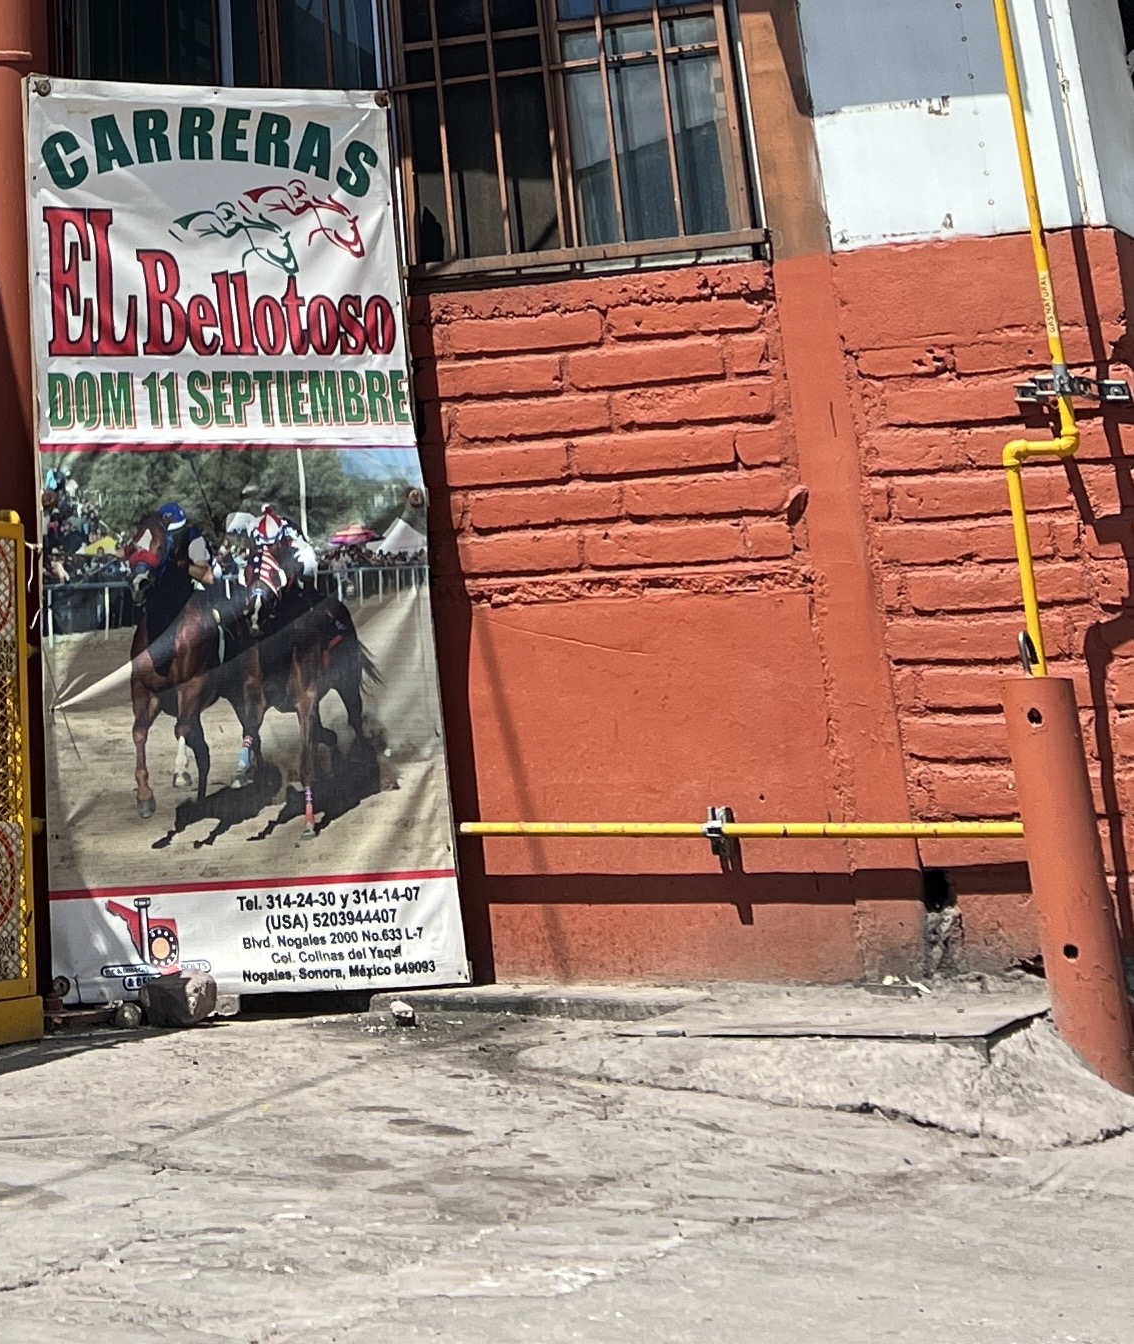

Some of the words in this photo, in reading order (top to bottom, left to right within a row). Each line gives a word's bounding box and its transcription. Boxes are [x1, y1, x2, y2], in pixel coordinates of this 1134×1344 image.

[41, 107, 379, 197] CARRERAS
[43, 207, 138, 357] EL
[136, 248, 397, 357] Bellotoso
[48, 371, 137, 430] DOM
[141, 371, 181, 430] 11
[186, 369, 411, 429] SEPTIEMBRE
[236, 895, 263, 911] Tel.
[266, 891, 336, 910] 314-24-30
[341, 892, 349, 909] y
[352, 886, 421, 904] 314-14-07
[265, 913, 309, 934] (USA)
[312, 908, 397, 928] 5203944407
[242, 935, 274, 949] Blvd.
[277, 932, 327, 950] Nogales
[329, 930, 359, 945] 2000
[361, 928, 403, 943] No.633
[405, 926, 424, 941] L-7
[271, 951, 296, 964] Col.
[298, 949, 345, 963] Colinas
[347, 947, 367, 960] del
[242, 969, 296, 985] Nogales,
[298, 967, 346, 982] Sonora,
[348, 962, 392, 979] México
[394, 960, 436, 976] 849093
